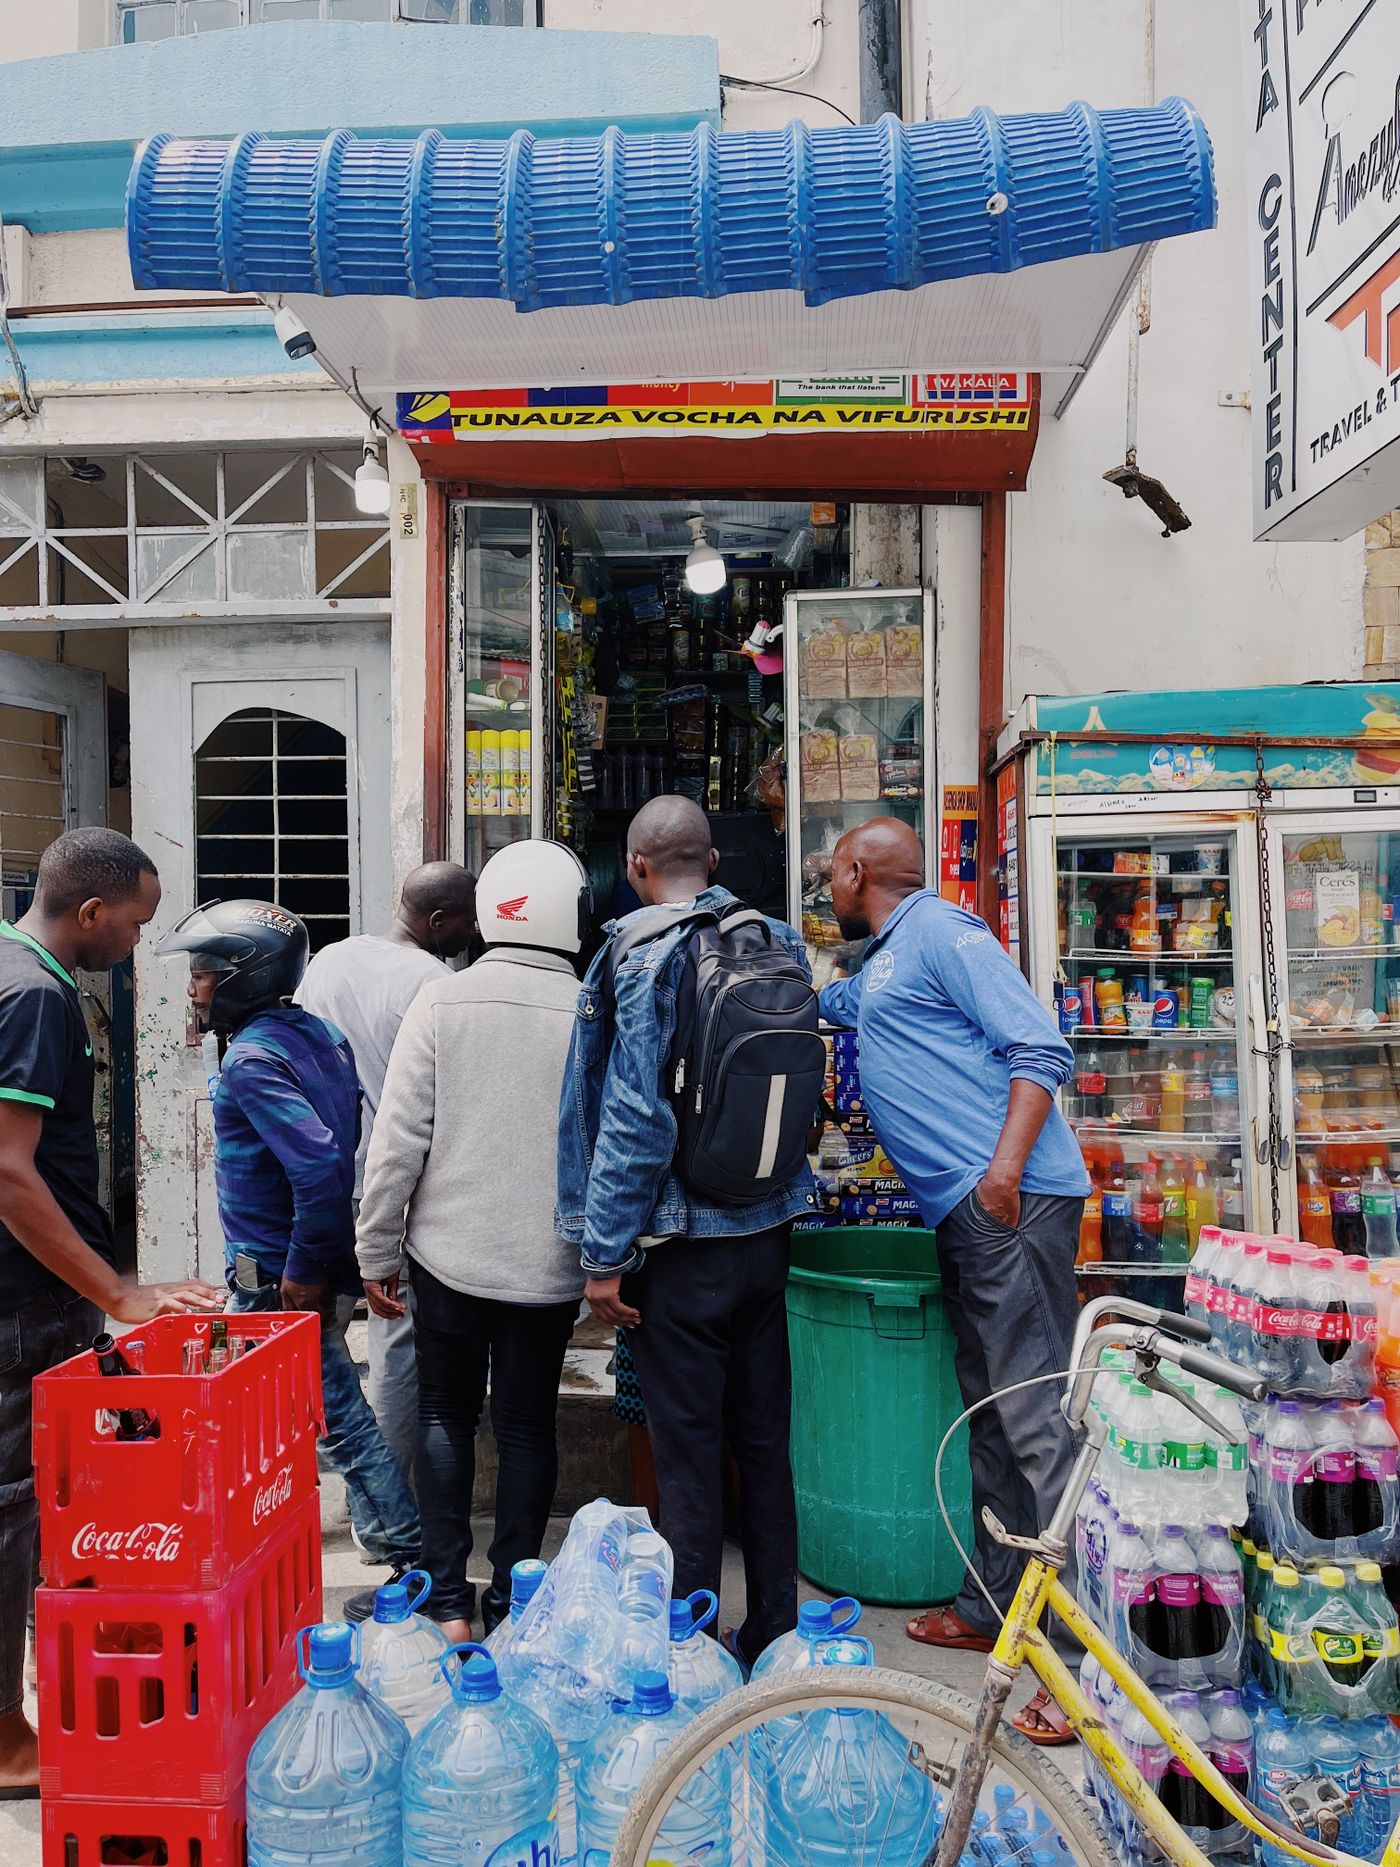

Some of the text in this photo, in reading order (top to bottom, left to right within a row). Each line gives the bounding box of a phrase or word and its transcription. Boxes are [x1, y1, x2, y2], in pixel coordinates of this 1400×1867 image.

[1259, 173, 1283, 510] CENTER
[933, 378, 1010, 388] WAKALA
[451, 410, 1028, 427] TUNAUZA VOCHA NA VIFURUSHI
[1310, 400, 1372, 464] TRAVEL
[1376, 387, 1387, 415] &
[402, 514, 413, 535] 002
[1320, 876, 1355, 887] Ceres
[235, 919, 291, 937] HAKUNA MATATA
[1064, 1016, 1081, 1024] pepsi
[253, 1462, 293, 1526] Coca-Cola
[72, 1522, 184, 1561] Coca-Cola
